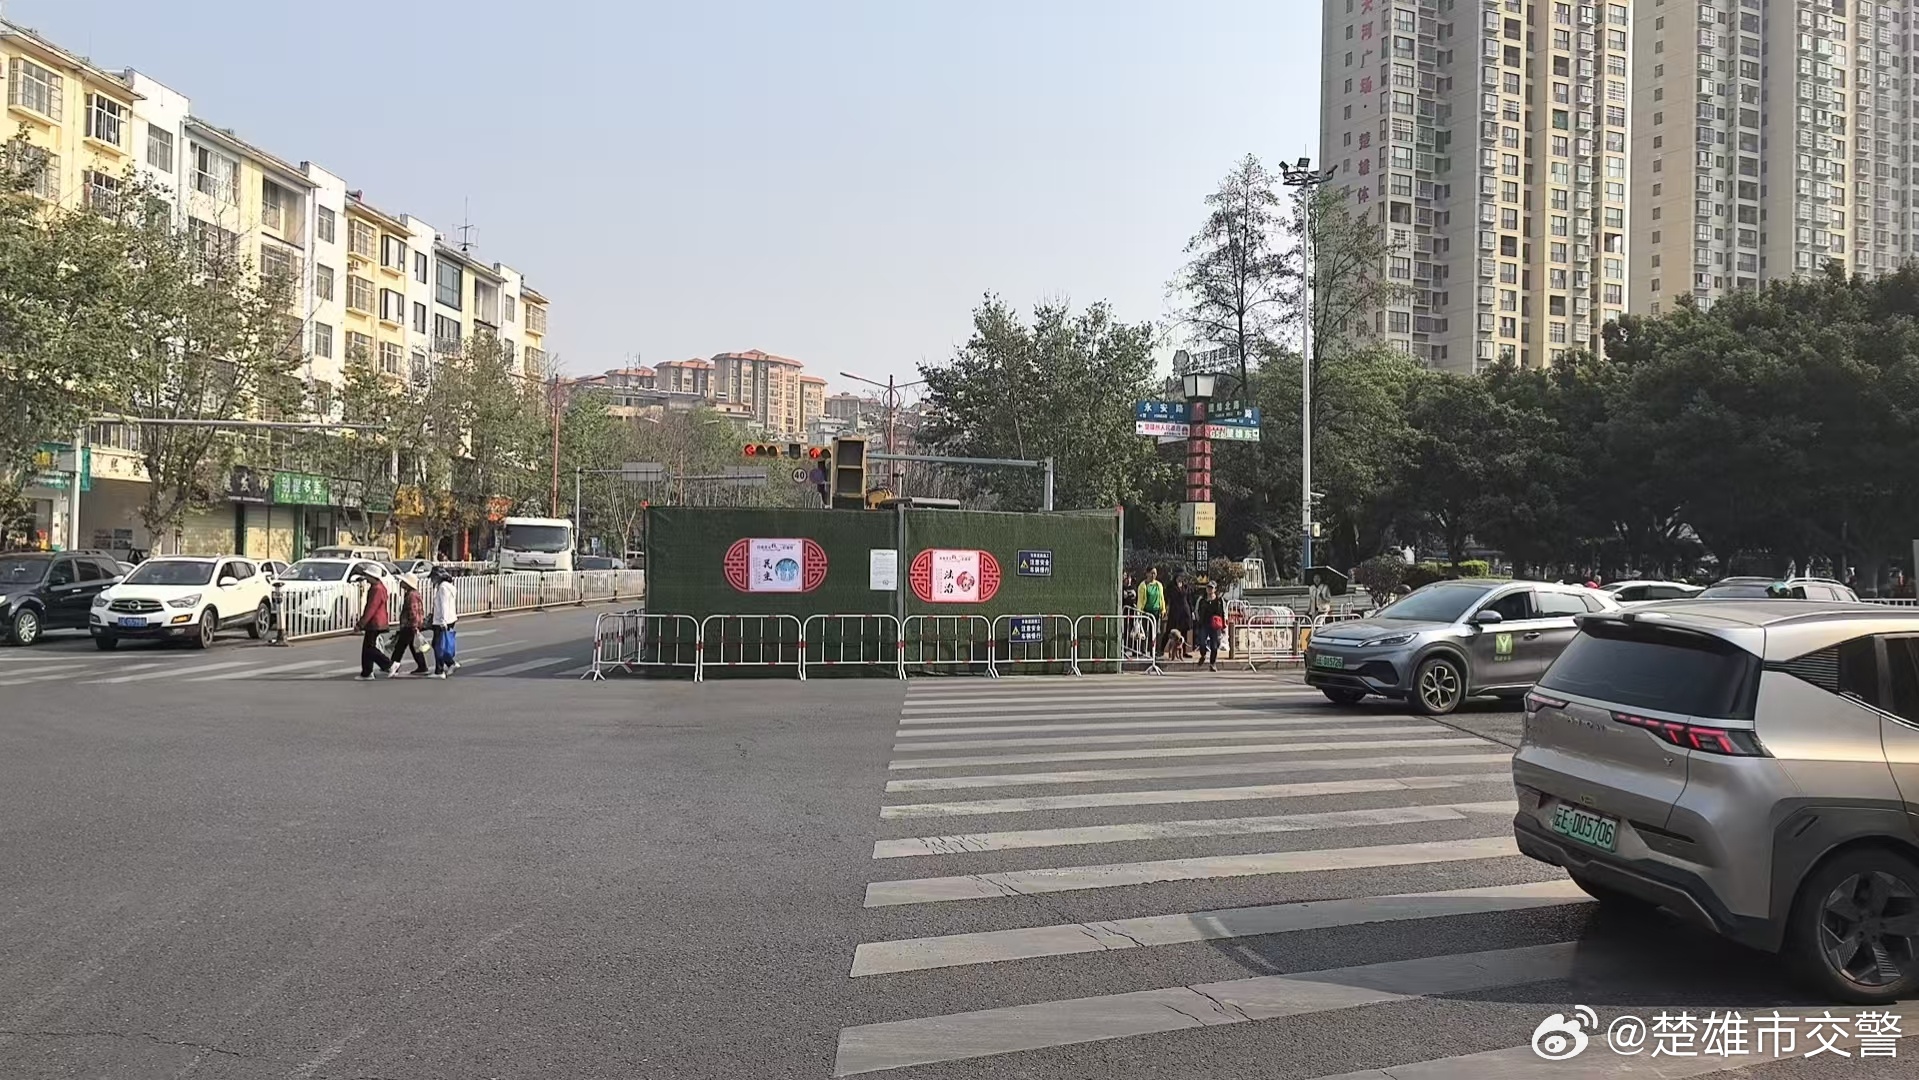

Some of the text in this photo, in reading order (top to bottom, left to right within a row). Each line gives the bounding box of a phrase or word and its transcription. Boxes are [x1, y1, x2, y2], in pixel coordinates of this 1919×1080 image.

[1144, 402, 1184, 413] 永安路
[795, 471, 805, 479] 40
[763, 559, 773, 582] 民主
[944, 569, 954, 594] 法治
